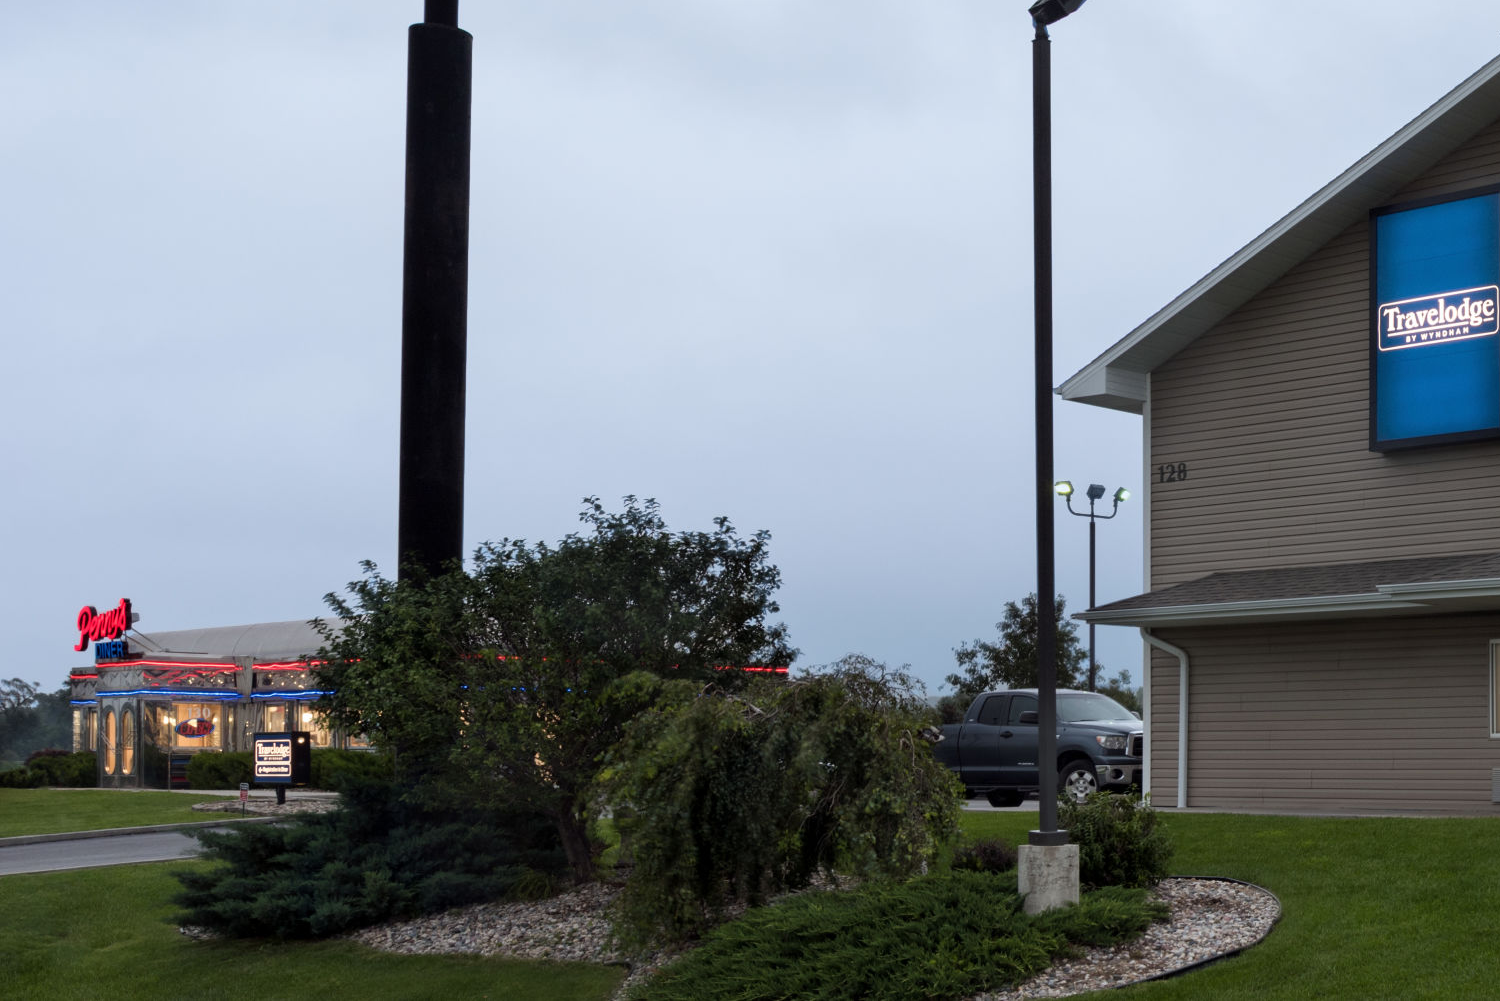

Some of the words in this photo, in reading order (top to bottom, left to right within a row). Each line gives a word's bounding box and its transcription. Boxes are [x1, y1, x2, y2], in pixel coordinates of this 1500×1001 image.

[1383, 297, 1495, 332] Travelodge
[1405, 334, 1417, 343] BY
[1420, 326, 1470, 341] WYNDHAM
[1158, 462, 1187, 483] 128
[95, 641, 125, 658] DINER
[187, 707, 211, 719] 130
